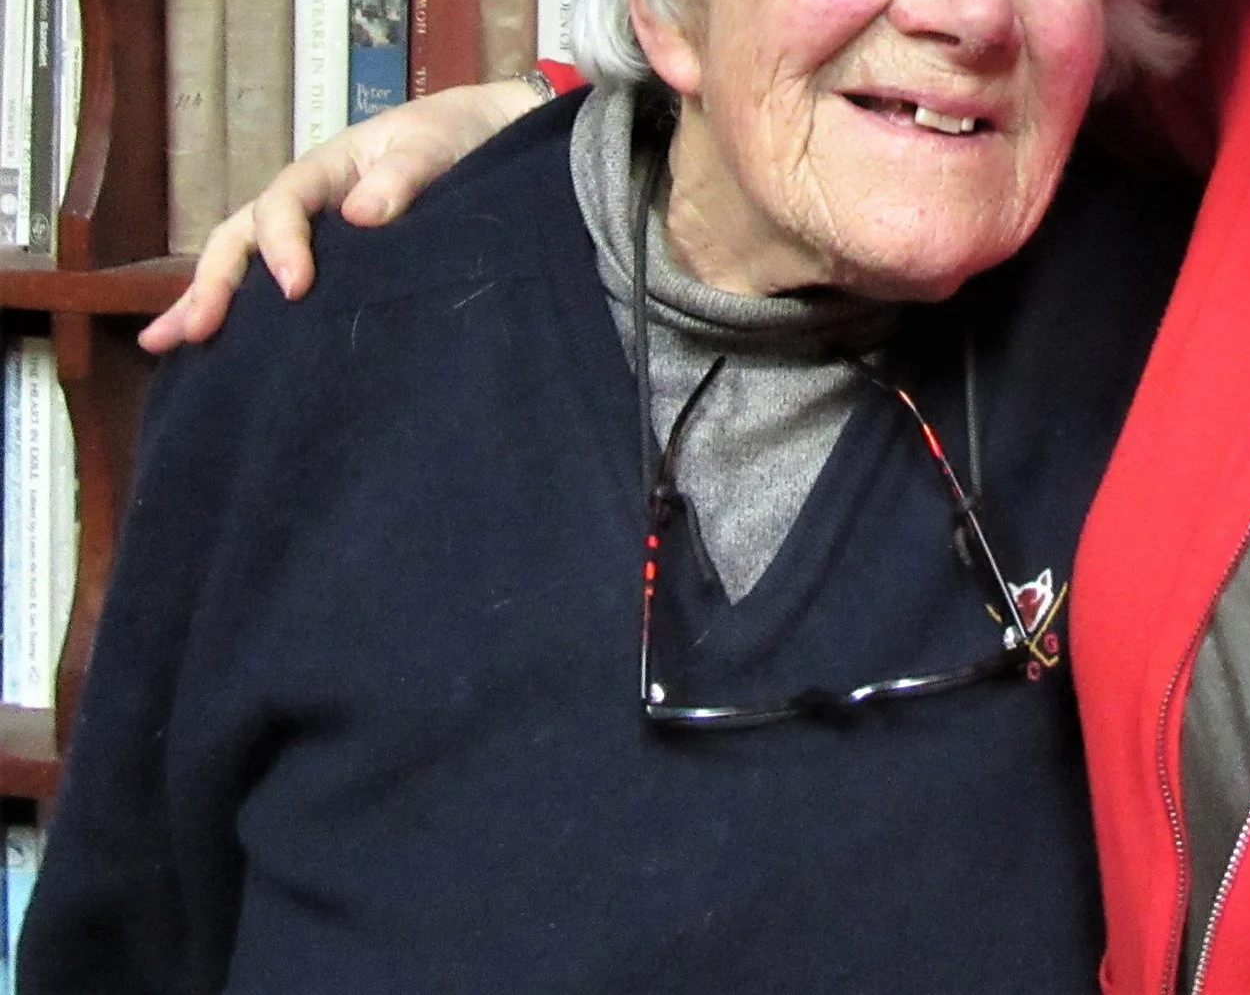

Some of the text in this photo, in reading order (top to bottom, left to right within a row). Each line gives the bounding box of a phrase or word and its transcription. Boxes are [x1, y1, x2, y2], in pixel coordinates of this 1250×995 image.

[309, 56, 326, 72] IN
[309, 84, 326, 113] THE
[355, 82, 392, 100] Peter
[29, 355, 40, 378] THE
[29, 382, 40, 425] HEART
[29, 428, 40, 442] IN
[29, 446, 40, 480] EXILE
